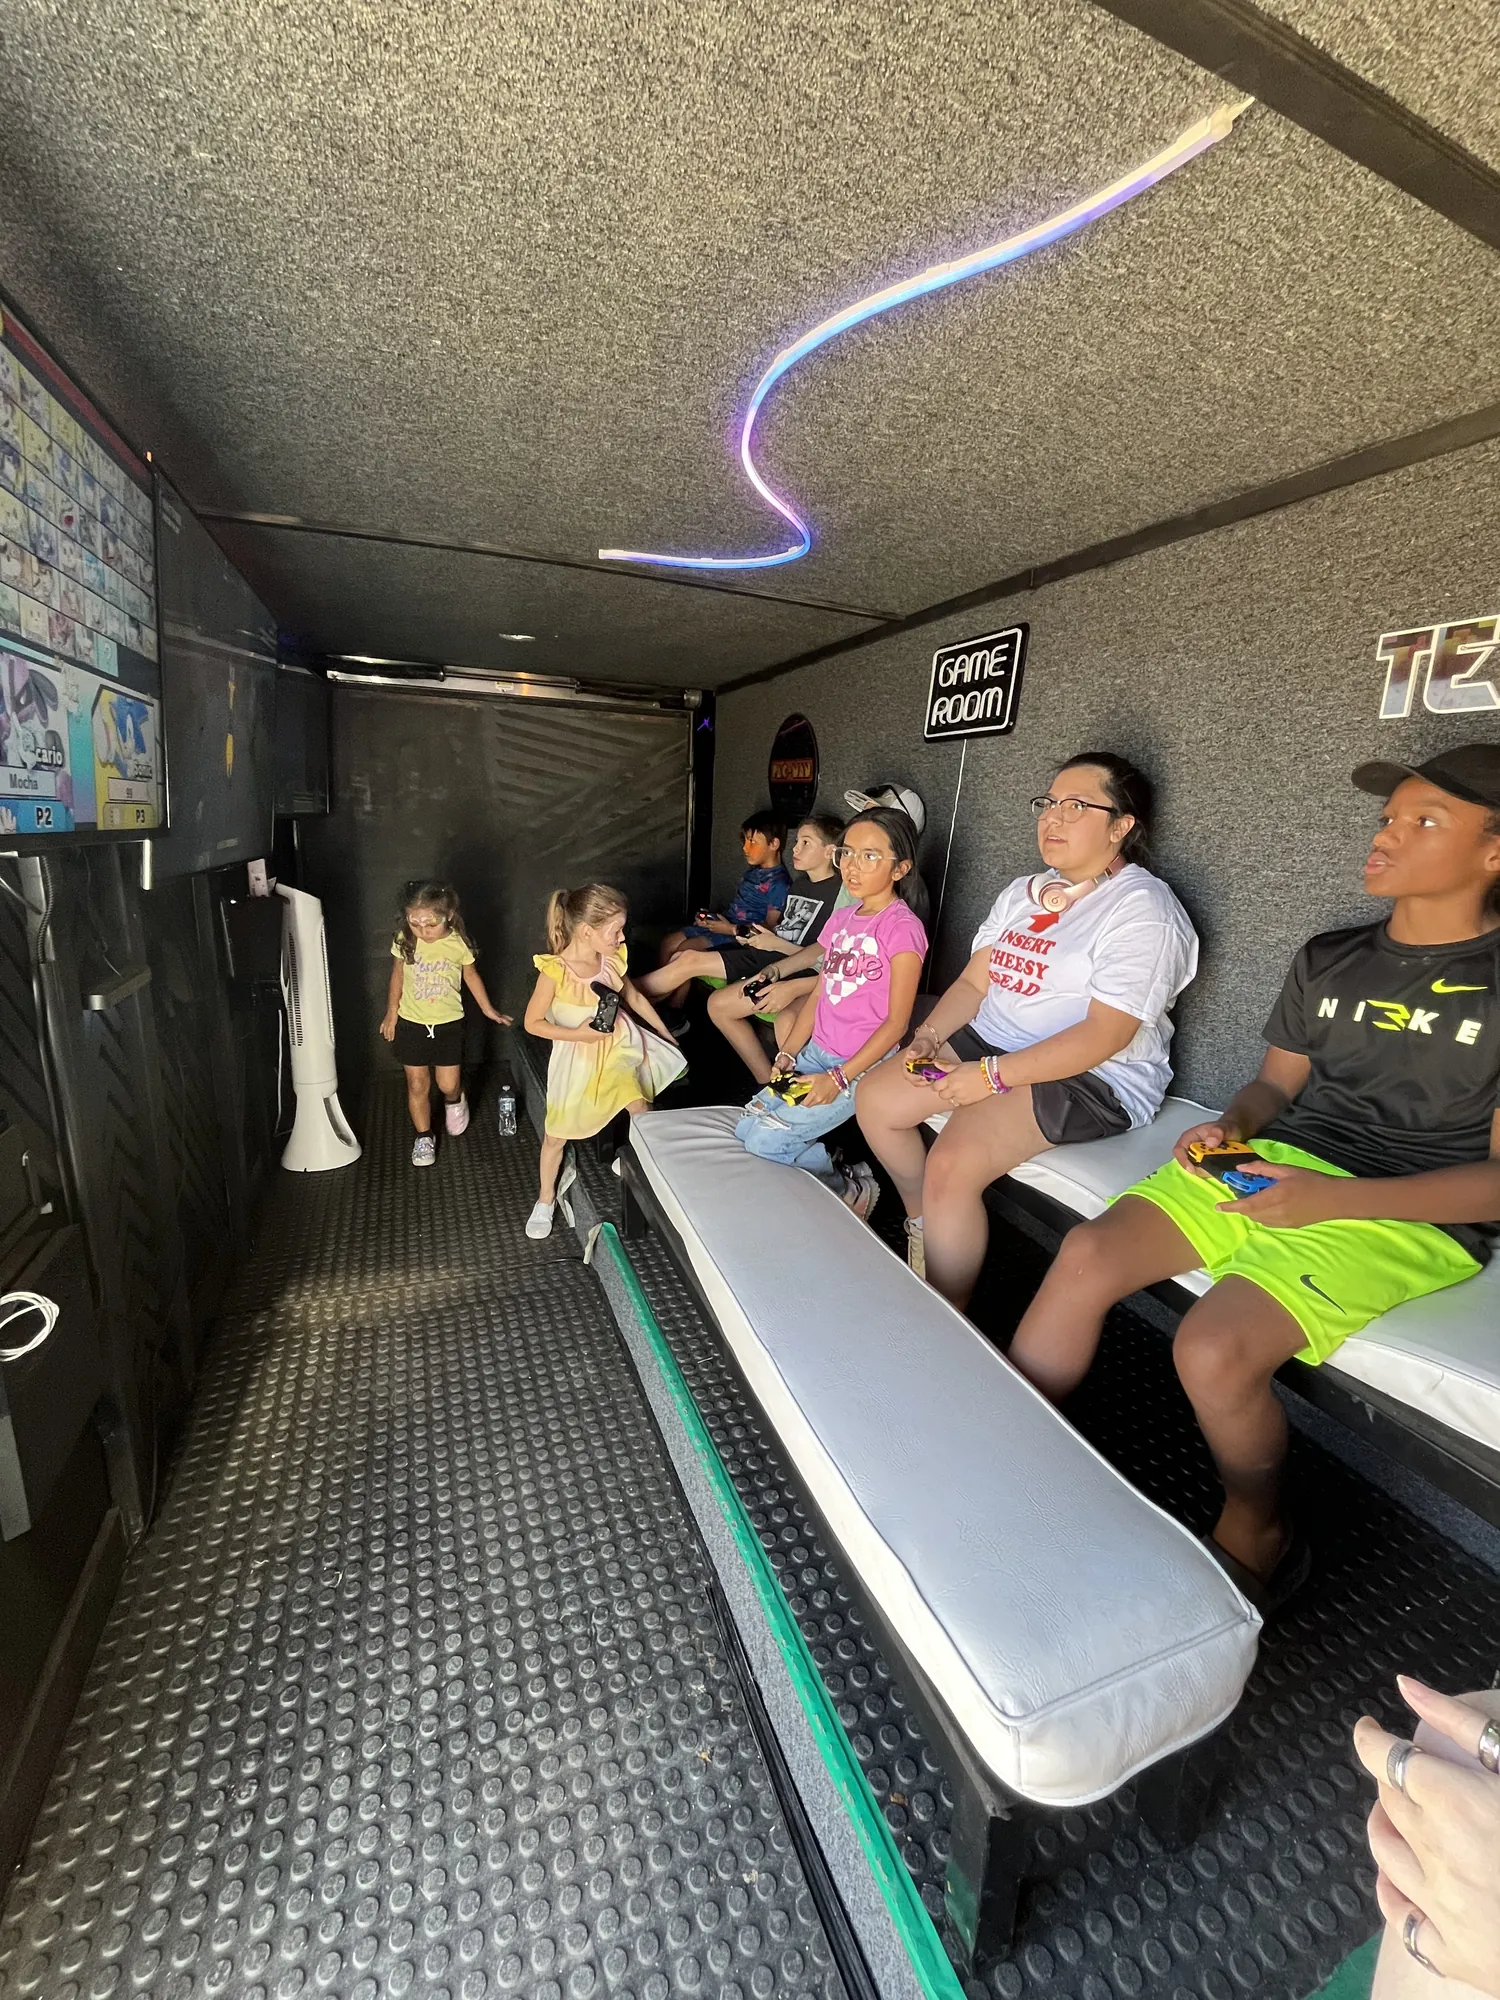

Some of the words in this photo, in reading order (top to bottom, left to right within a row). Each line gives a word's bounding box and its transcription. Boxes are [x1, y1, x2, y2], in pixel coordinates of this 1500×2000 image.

[938, 643, 1010, 688] GAME
[1376, 614, 1500, 719] TE
[930, 686, 1004, 727] ROOM
[35, 745, 64, 766] cario
[9, 772, 39, 791] Mocha
[35, 805, 54, 828] P2
[135, 808, 146, 824] P3
[998, 928, 1057, 956] INSERT
